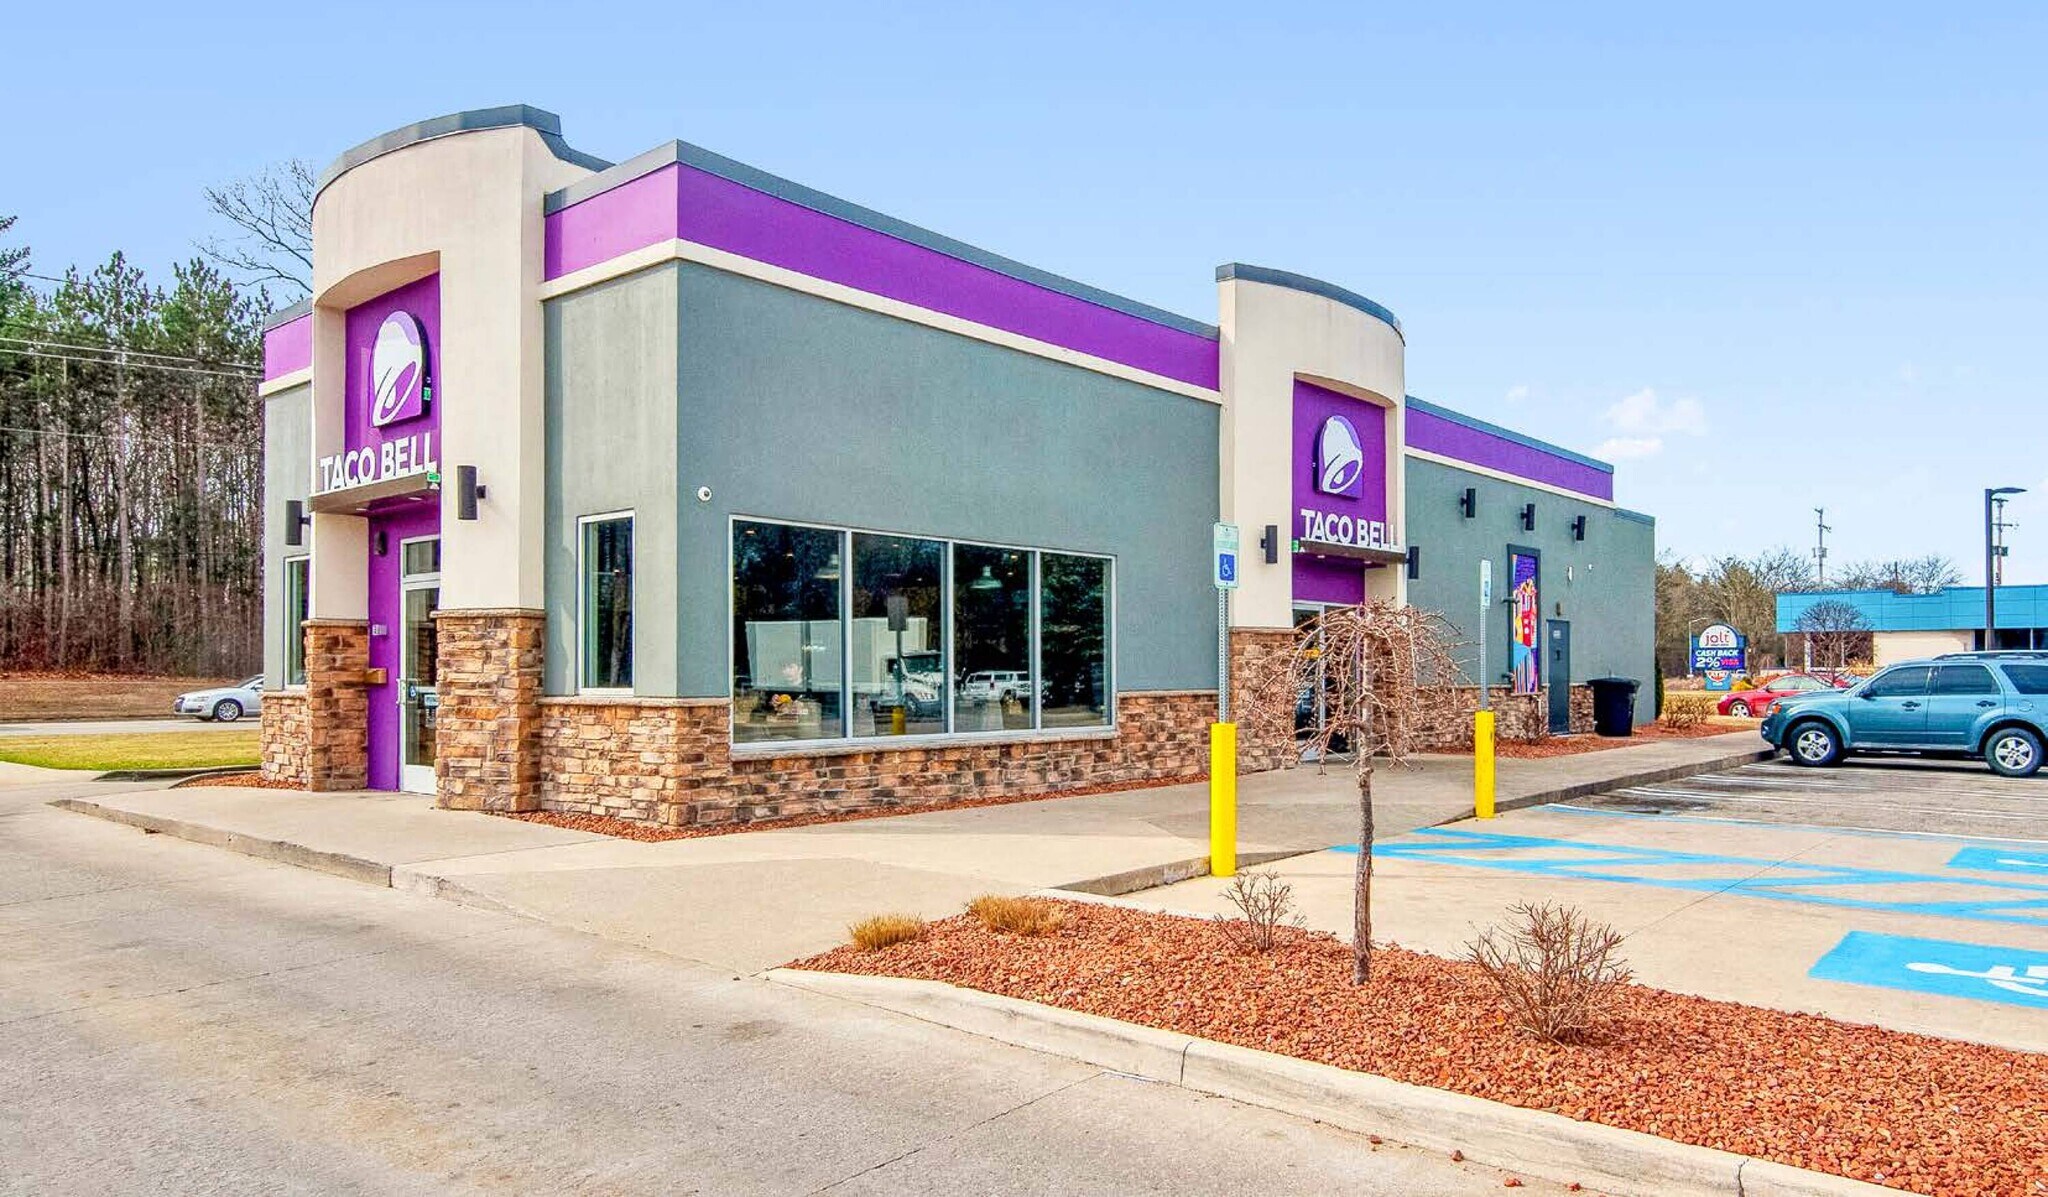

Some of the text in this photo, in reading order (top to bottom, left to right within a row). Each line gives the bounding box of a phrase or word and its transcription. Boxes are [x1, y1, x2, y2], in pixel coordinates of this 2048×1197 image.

[320, 432, 437, 492] TACO BELL
[1300, 508, 1399, 551] TACO BELL
[1705, 630, 1730, 647] jolt
[1695, 649, 1739, 657] CASH BACK
[1695, 656, 1721, 668] 2%
